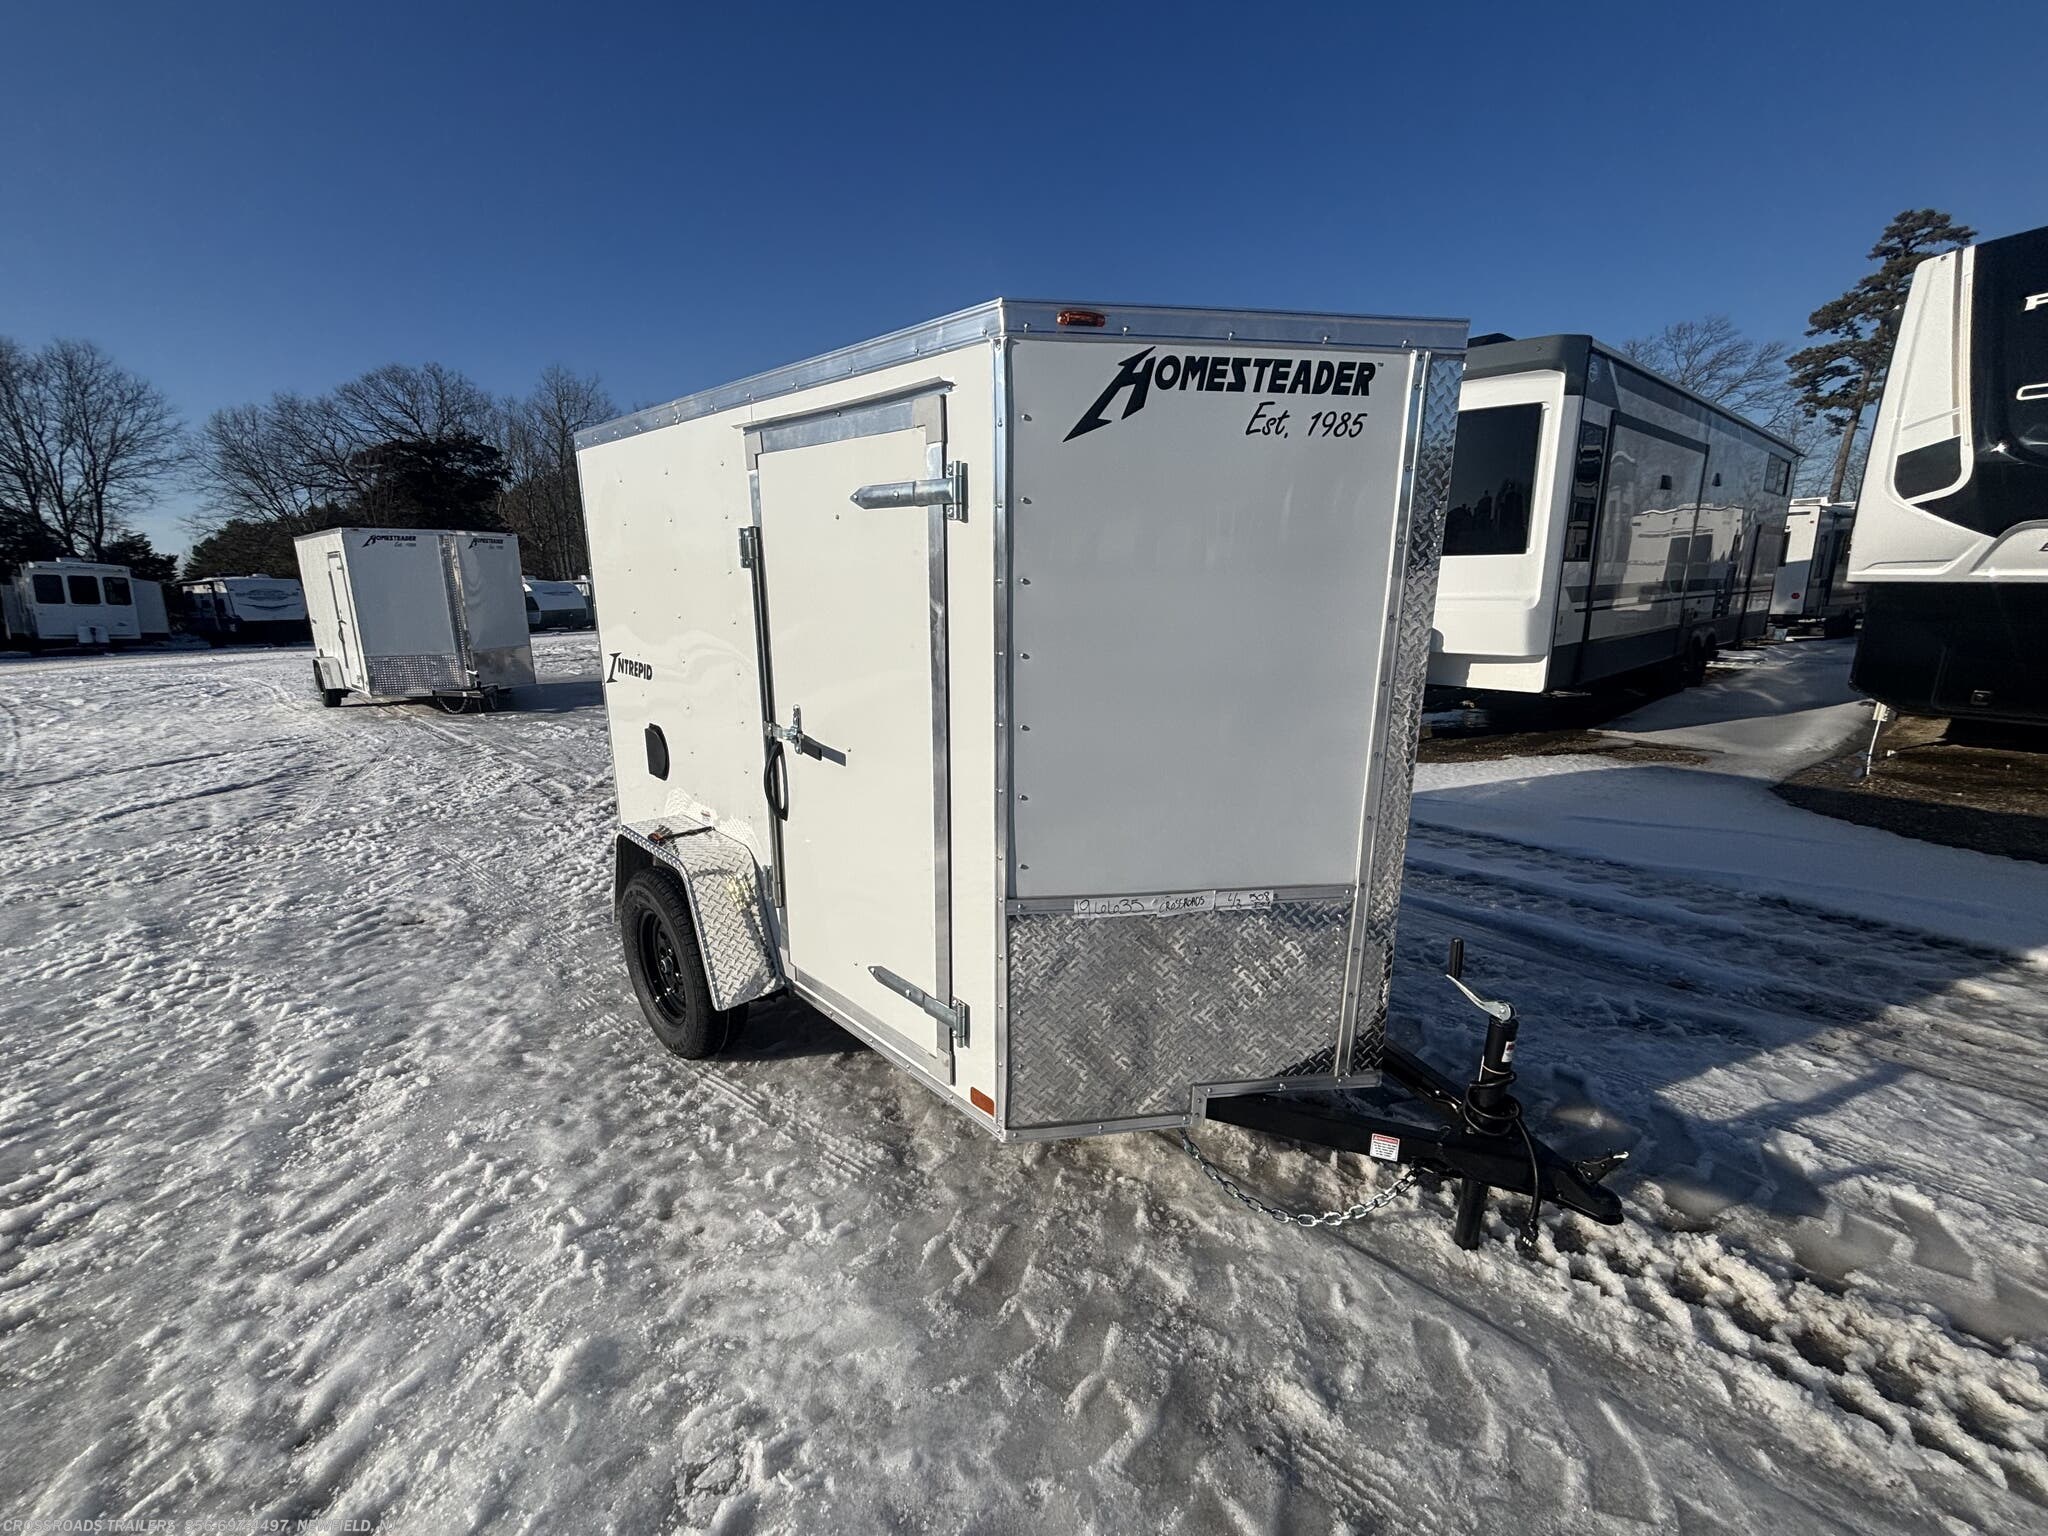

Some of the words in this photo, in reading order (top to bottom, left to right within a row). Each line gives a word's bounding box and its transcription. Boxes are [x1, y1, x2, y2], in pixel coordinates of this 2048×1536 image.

[1245, 401, 1289, 439] Est.
[1307, 412, 1368, 438] 1985
[606, 652, 653, 683] INTREPID
